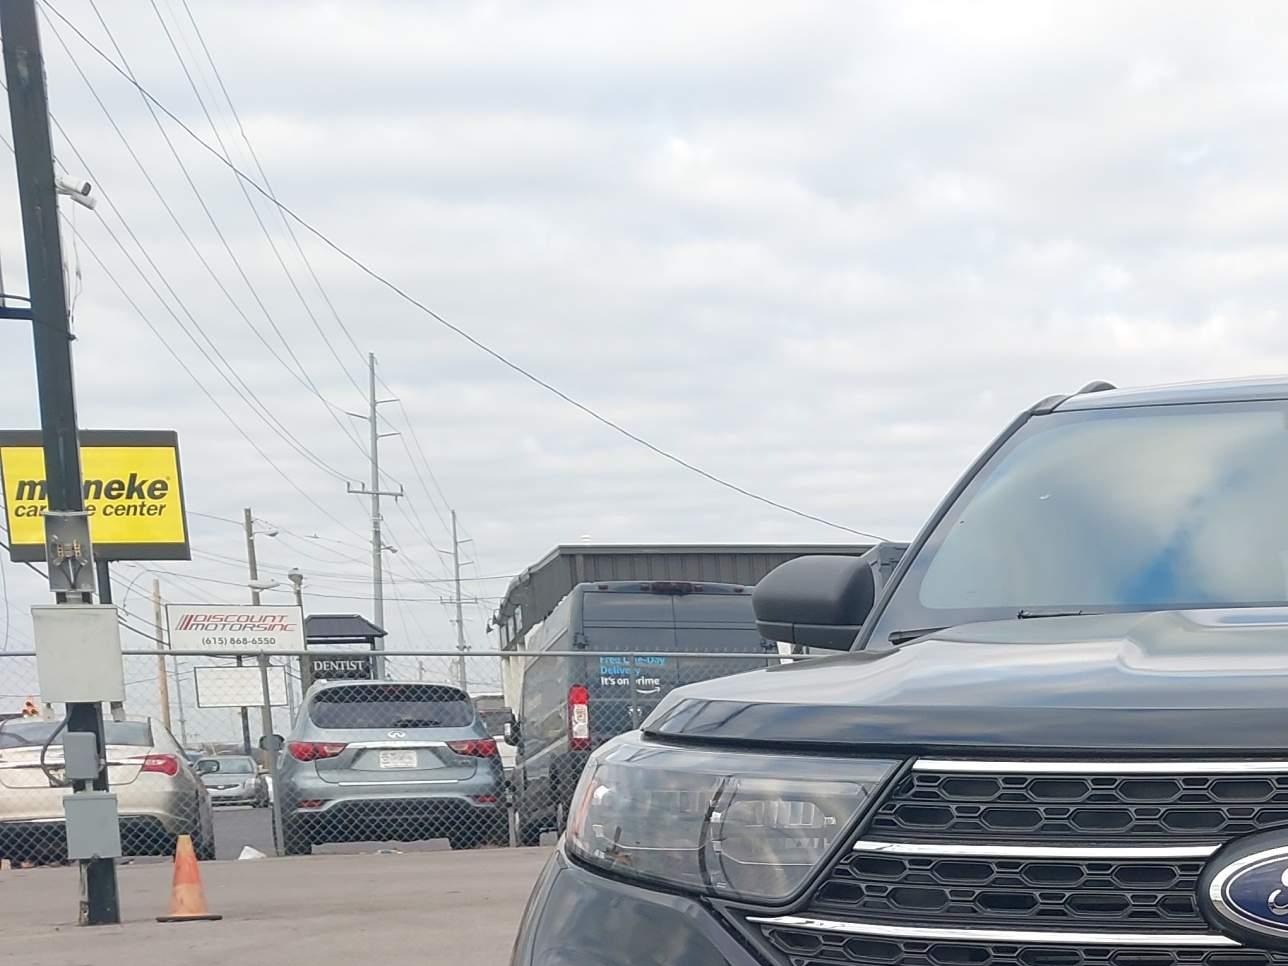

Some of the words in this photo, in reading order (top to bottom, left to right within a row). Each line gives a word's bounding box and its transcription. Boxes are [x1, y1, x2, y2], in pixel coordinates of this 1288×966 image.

[15, 473, 169, 501] mneke
[102, 501, 167, 517] center
[192, 614, 289, 623] DISCOUNT
[202, 637, 228, 646] (615)
[230, 637, 276, 645] 868-6550
[313, 660, 365, 671] DENTIST
